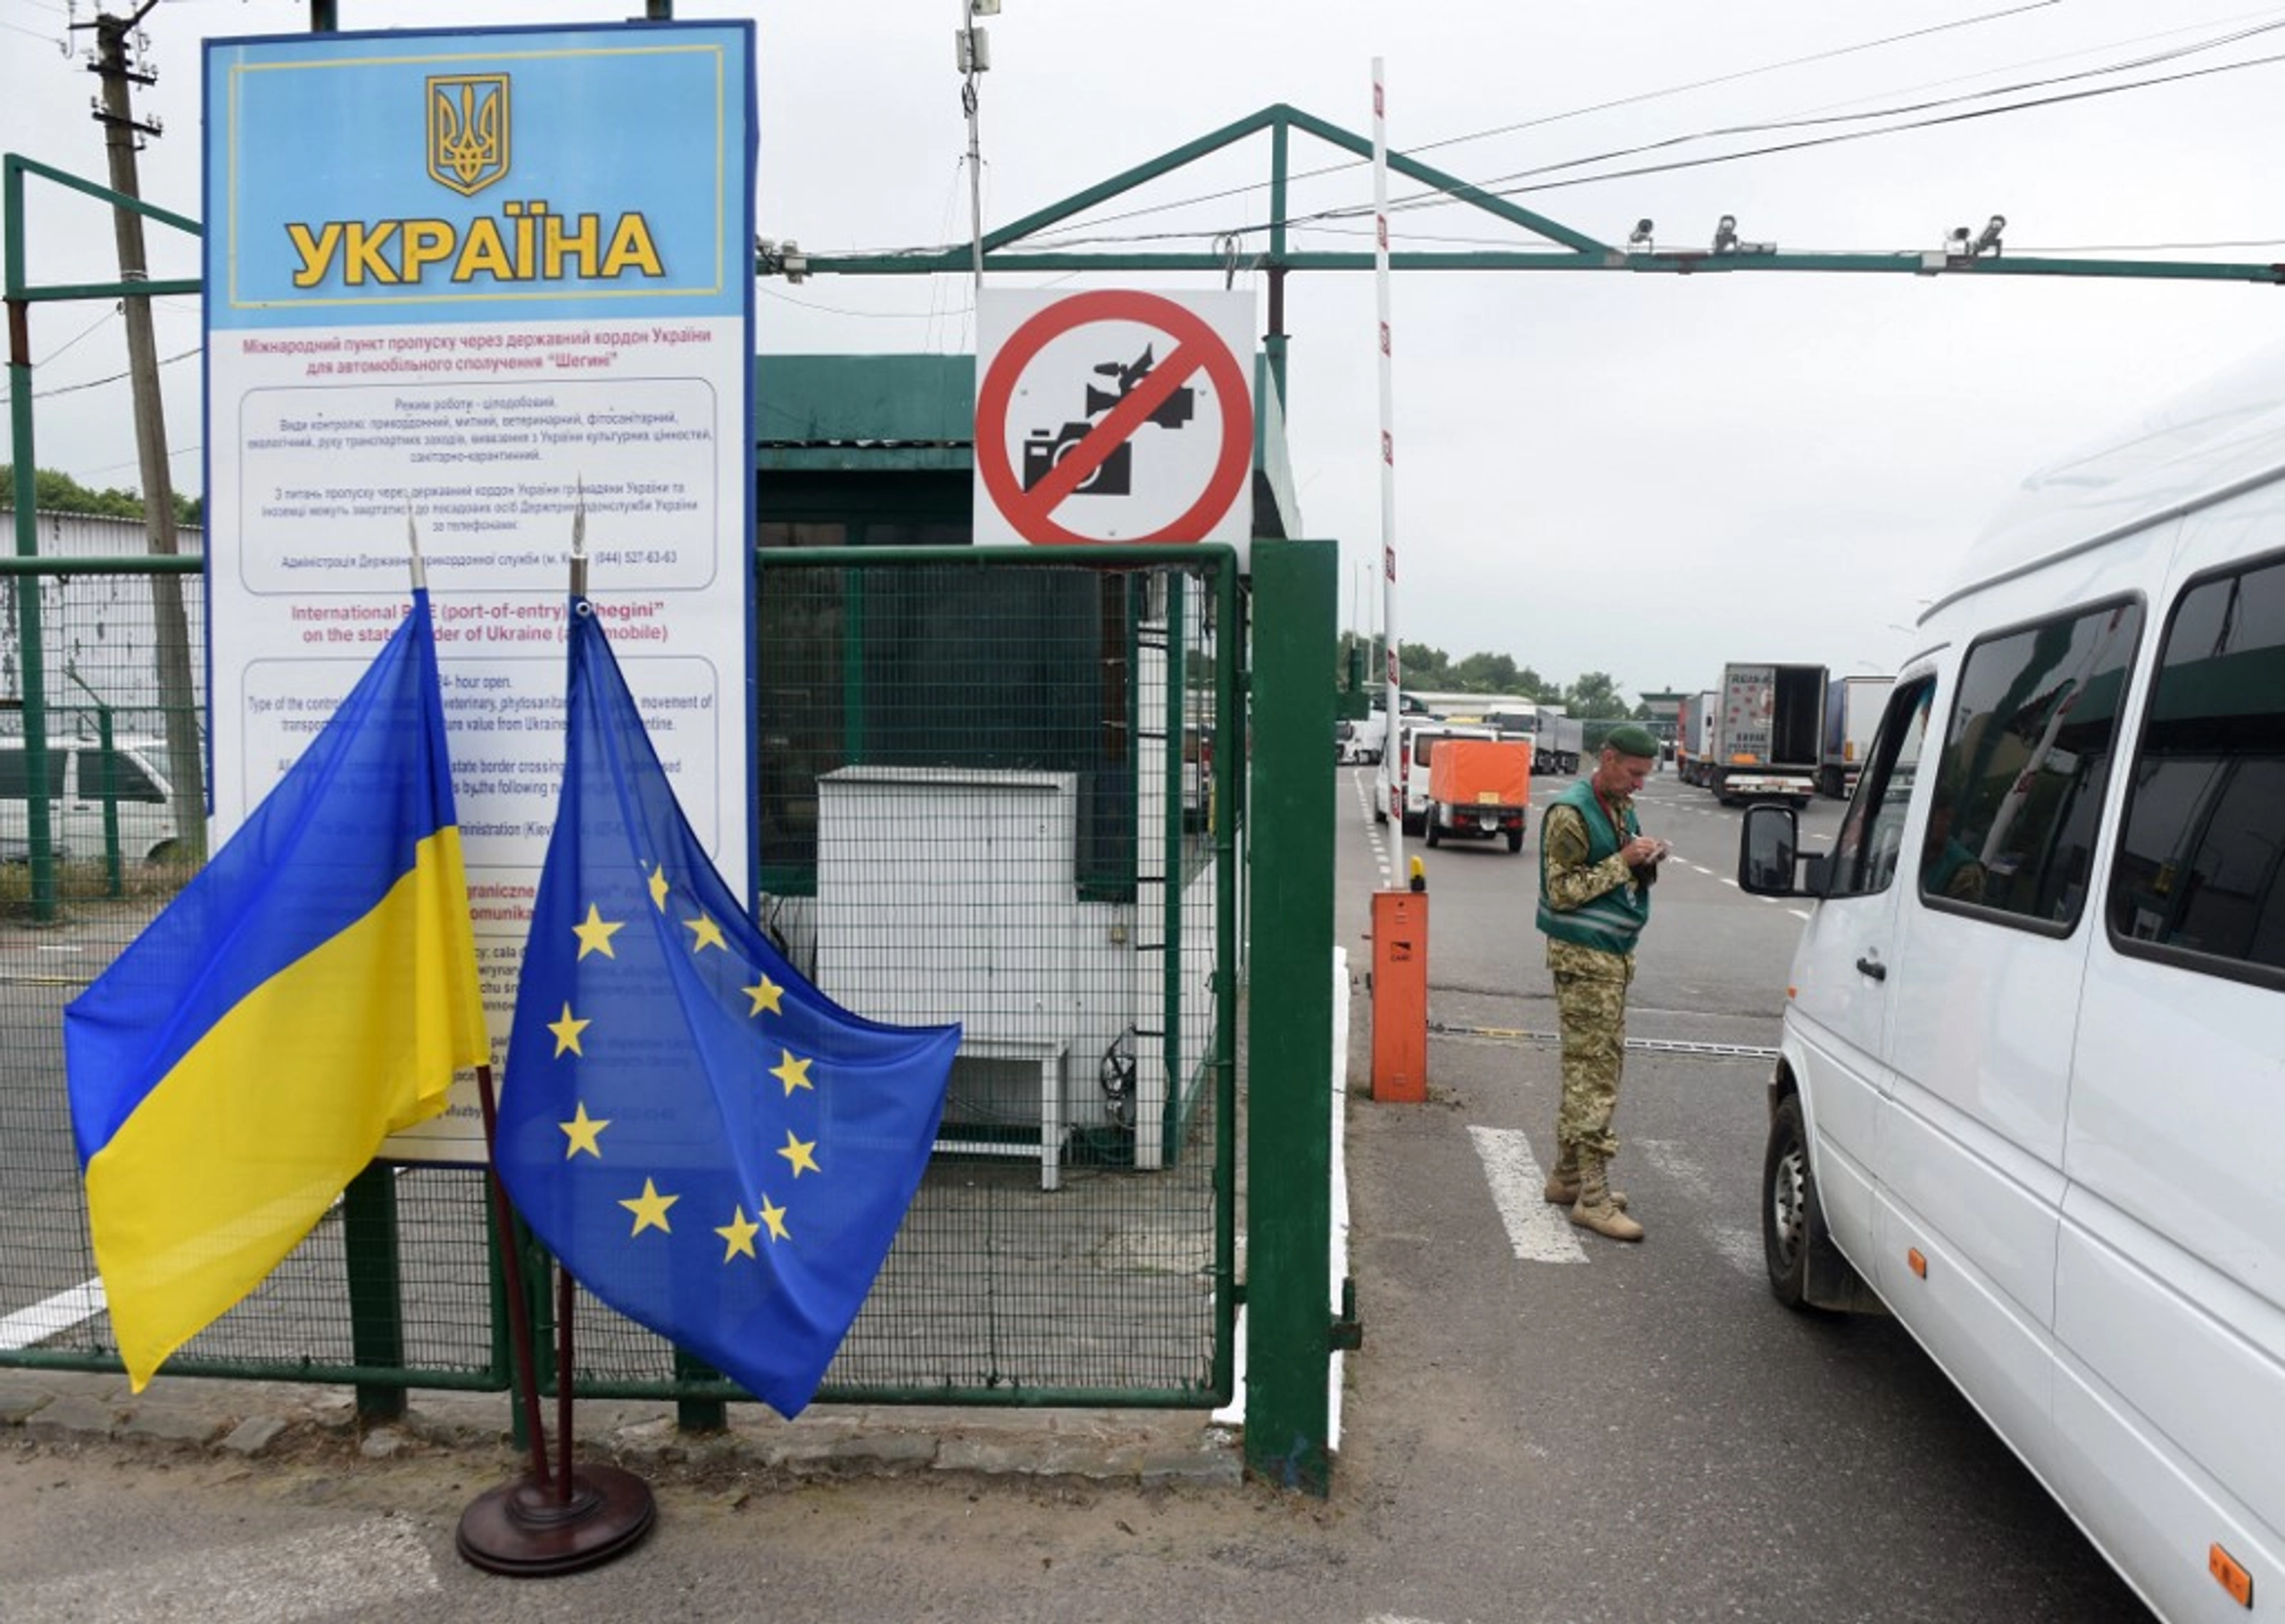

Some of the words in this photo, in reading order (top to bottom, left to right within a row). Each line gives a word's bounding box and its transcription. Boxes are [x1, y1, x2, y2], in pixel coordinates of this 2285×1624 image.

[285, 200, 666, 289] УКРАЇНА
[243, 336, 341, 355] Міжнародний
[344, 338, 384, 354] пункт
[388, 336, 456, 352] пропуску
[460, 336, 503, 350] через
[507, 331, 590, 349] державний
[594, 332, 649, 347] кордон
[652, 327, 711, 345] України
[306, 362, 334, 376] для
[337, 357, 453, 374] автомобільного
[455, 358, 543, 373] сполучення
[425, 555, 494, 568] рикордонної
[291, 604, 396, 622] International
[303, 629, 323, 642] on
[327, 627, 354, 642] the
[464, 626, 482, 641] of
[486, 626, 553, 641] Ukraine
[455, 673, 480, 688] hour
[275, 696, 286, 710] of
[641, 695, 698, 709] movement
[701, 694, 712, 709] of
[479, 758, 516, 774] border
[497, 779, 548, 797] following
